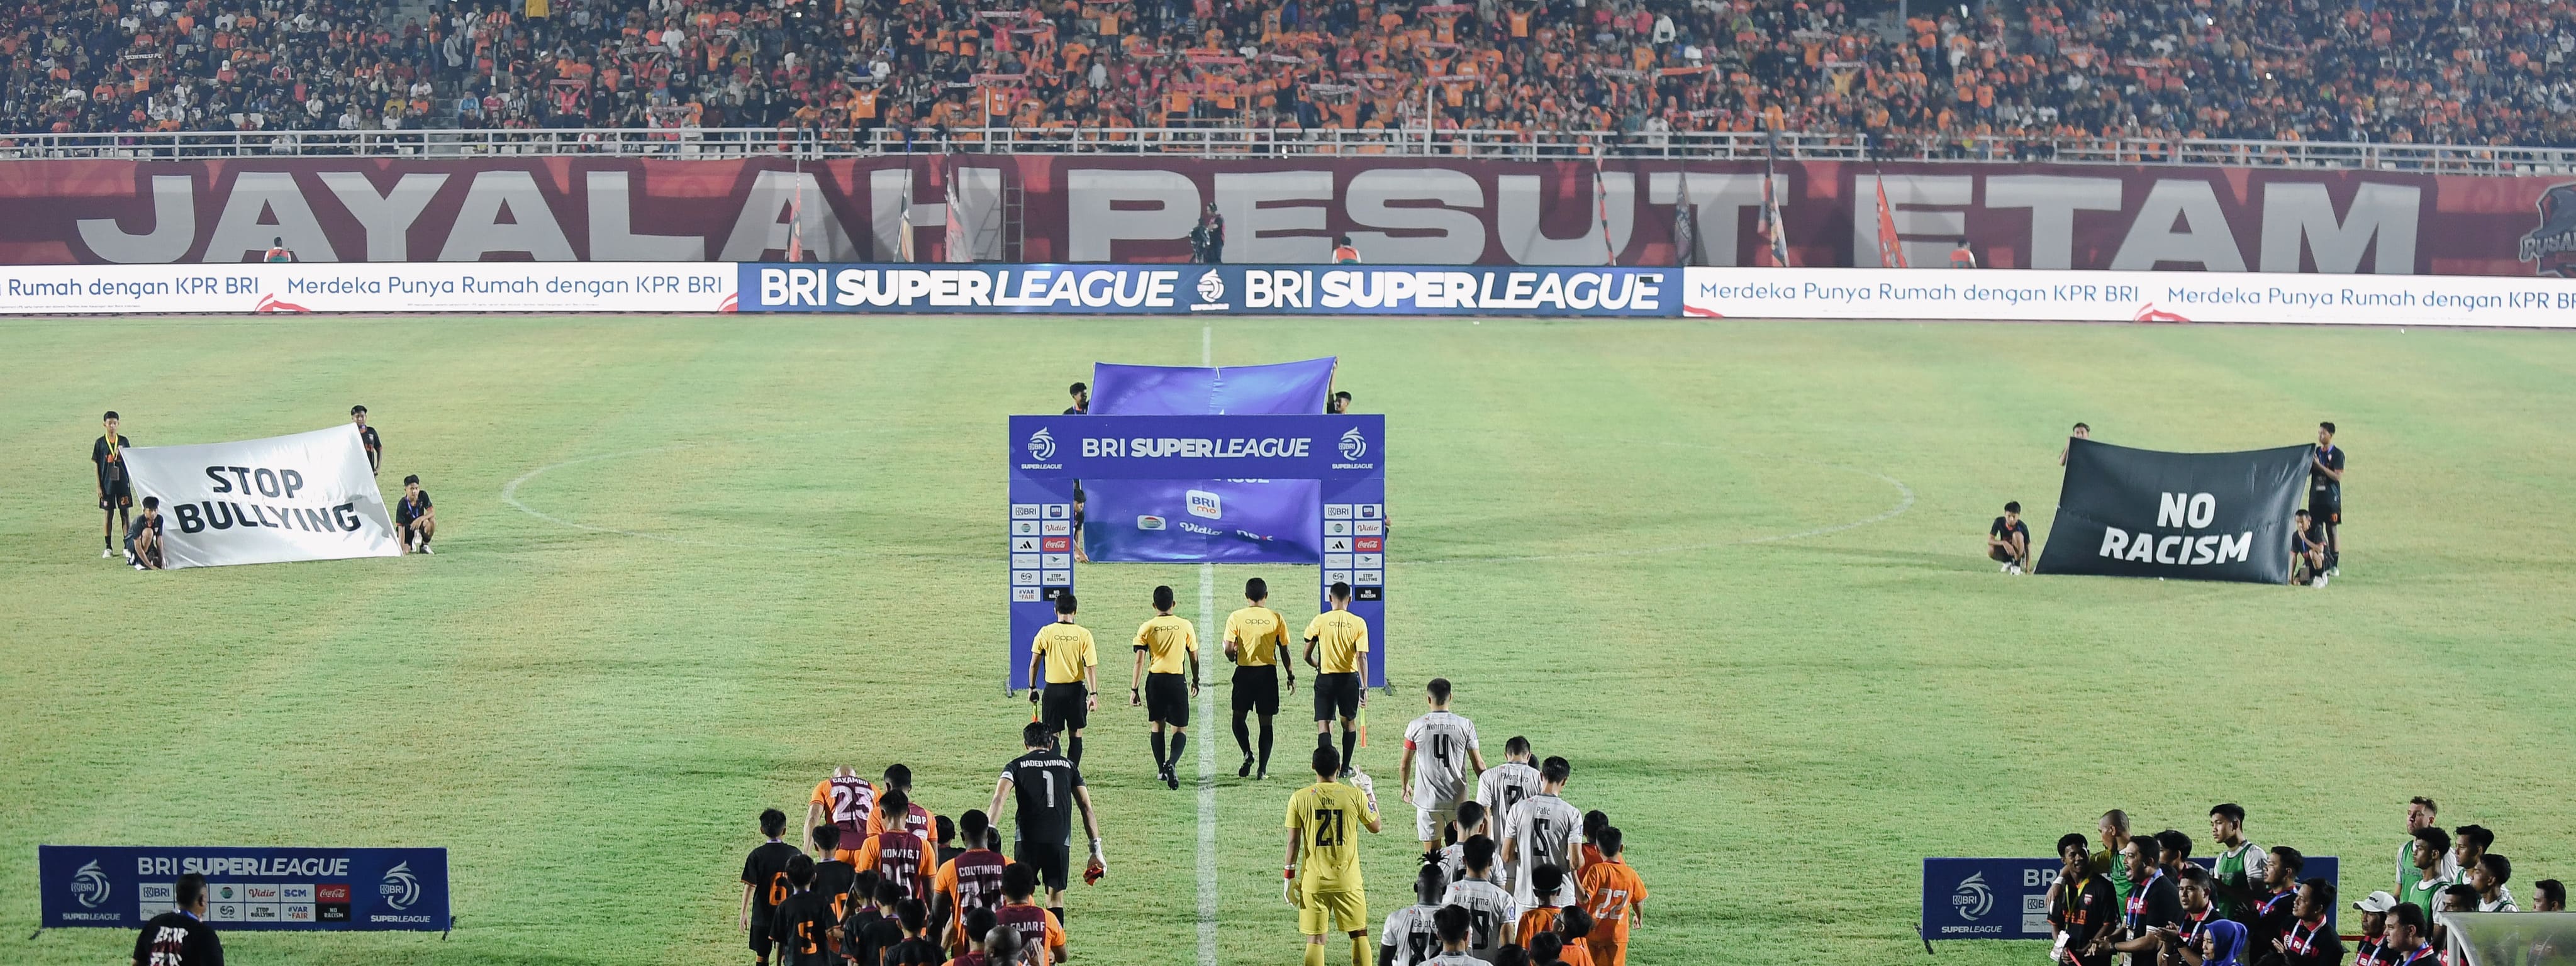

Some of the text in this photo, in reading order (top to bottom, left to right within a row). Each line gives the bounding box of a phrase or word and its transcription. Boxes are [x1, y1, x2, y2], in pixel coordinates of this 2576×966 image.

[76, 167, 2421, 274] JAYALAH PESUT ETAM
[9, 277, 259, 299] Rumah dengan KPR BRI
[288, 276, 722, 297] Merdeka Punya Rumah dengan KPR BRI
[761, 269, 827, 306] BRI
[1246, 270, 1312, 308] BRI
[1700, 282, 2139, 306] Merdeka Punya Rumah dengan KPR BRI
[2168, 287, 2260, 305] Merdeka
[2268, 287, 2333, 309] Punya
[2341, 289, 2415, 308] Rumah
[2423, 289, 2502, 313] dengan
[2509, 291, 2548, 309] KPR
[1083, 438, 1125, 457] BRI
[205, 465, 303, 499] STOP
[1191, 496, 1215, 508] BRI
[1196, 505, 1217, 514] mo
[1337, 508, 1349, 516] BRI
[2156, 491, 2216, 529] NO
[174, 501, 362, 534] BULLYING
[1045, 524, 1067, 532] Vidio
[1179, 521, 1223, 536] Vidio
[1357, 524, 1379, 532] Vidio
[2099, 526, 2253, 565] RACISM
[1434, 734, 1449, 768] 4
[1044, 759, 1071, 769] WINATA
[1042, 770, 1054, 808] 1
[830, 785, 875, 823] 23
[1315, 809, 1343, 847] 21
[1533, 818, 1550, 857] 5
[138, 857, 177, 875] BRI
[959, 865, 1002, 877] COUTINHO
[154, 888, 170, 897] BRI
[248, 888, 276, 898] Vidio
[284, 889, 307, 897] SCM
[389, 885, 403, 894] BRI
[769, 872, 787, 906] 6
[1454, 894, 1462, 904] Aji
[1962, 896, 1977, 904] BRI
[1595, 887, 1628, 920] 22
[798, 921, 817, 955] 5
